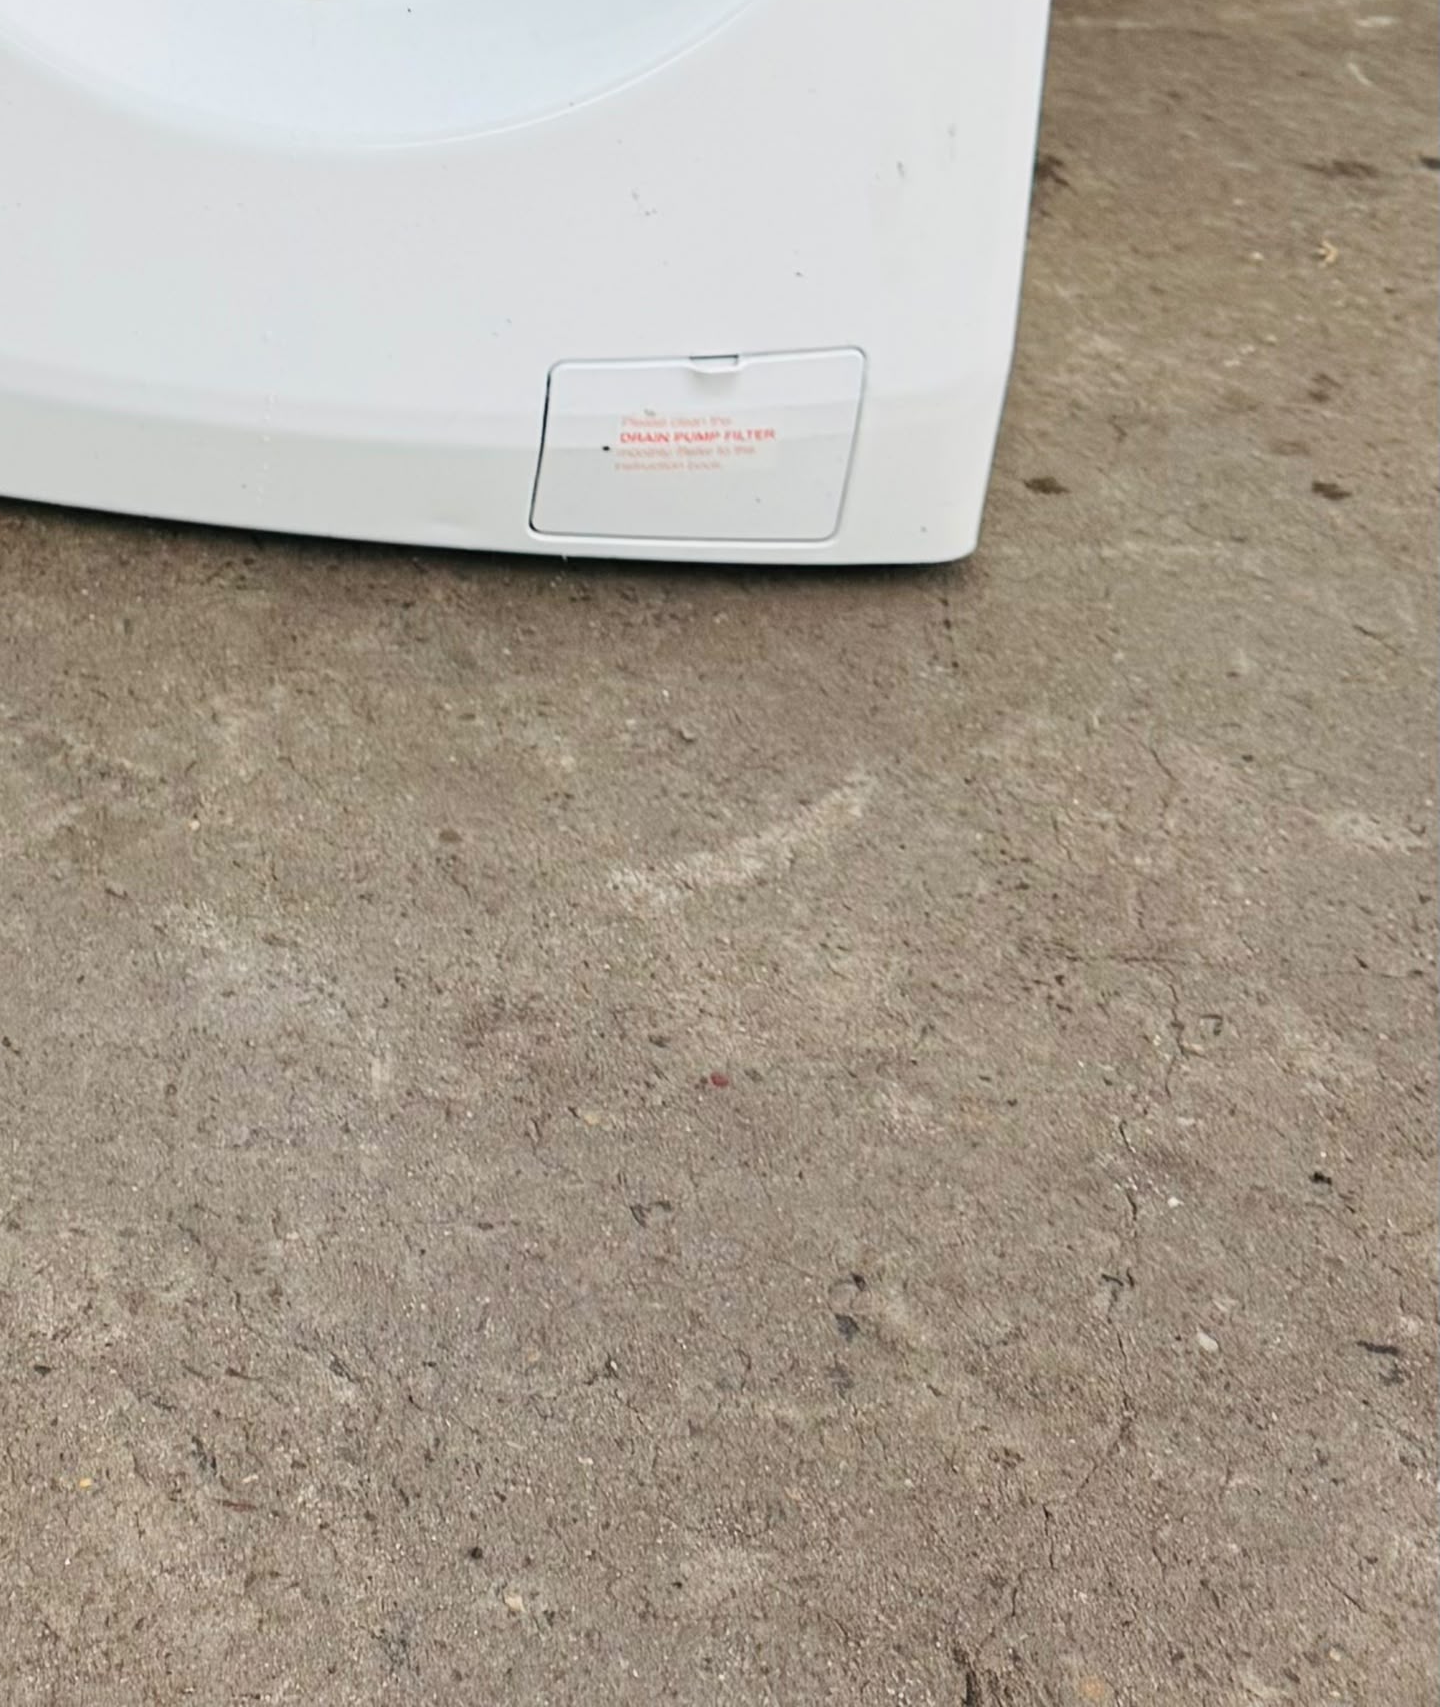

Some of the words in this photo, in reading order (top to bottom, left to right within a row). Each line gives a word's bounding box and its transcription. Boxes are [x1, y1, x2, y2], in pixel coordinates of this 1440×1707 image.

[620, 431, 670, 444] DRAIN
[674, 430, 721, 444] PUMP
[724, 428, 776, 442] FILTER
